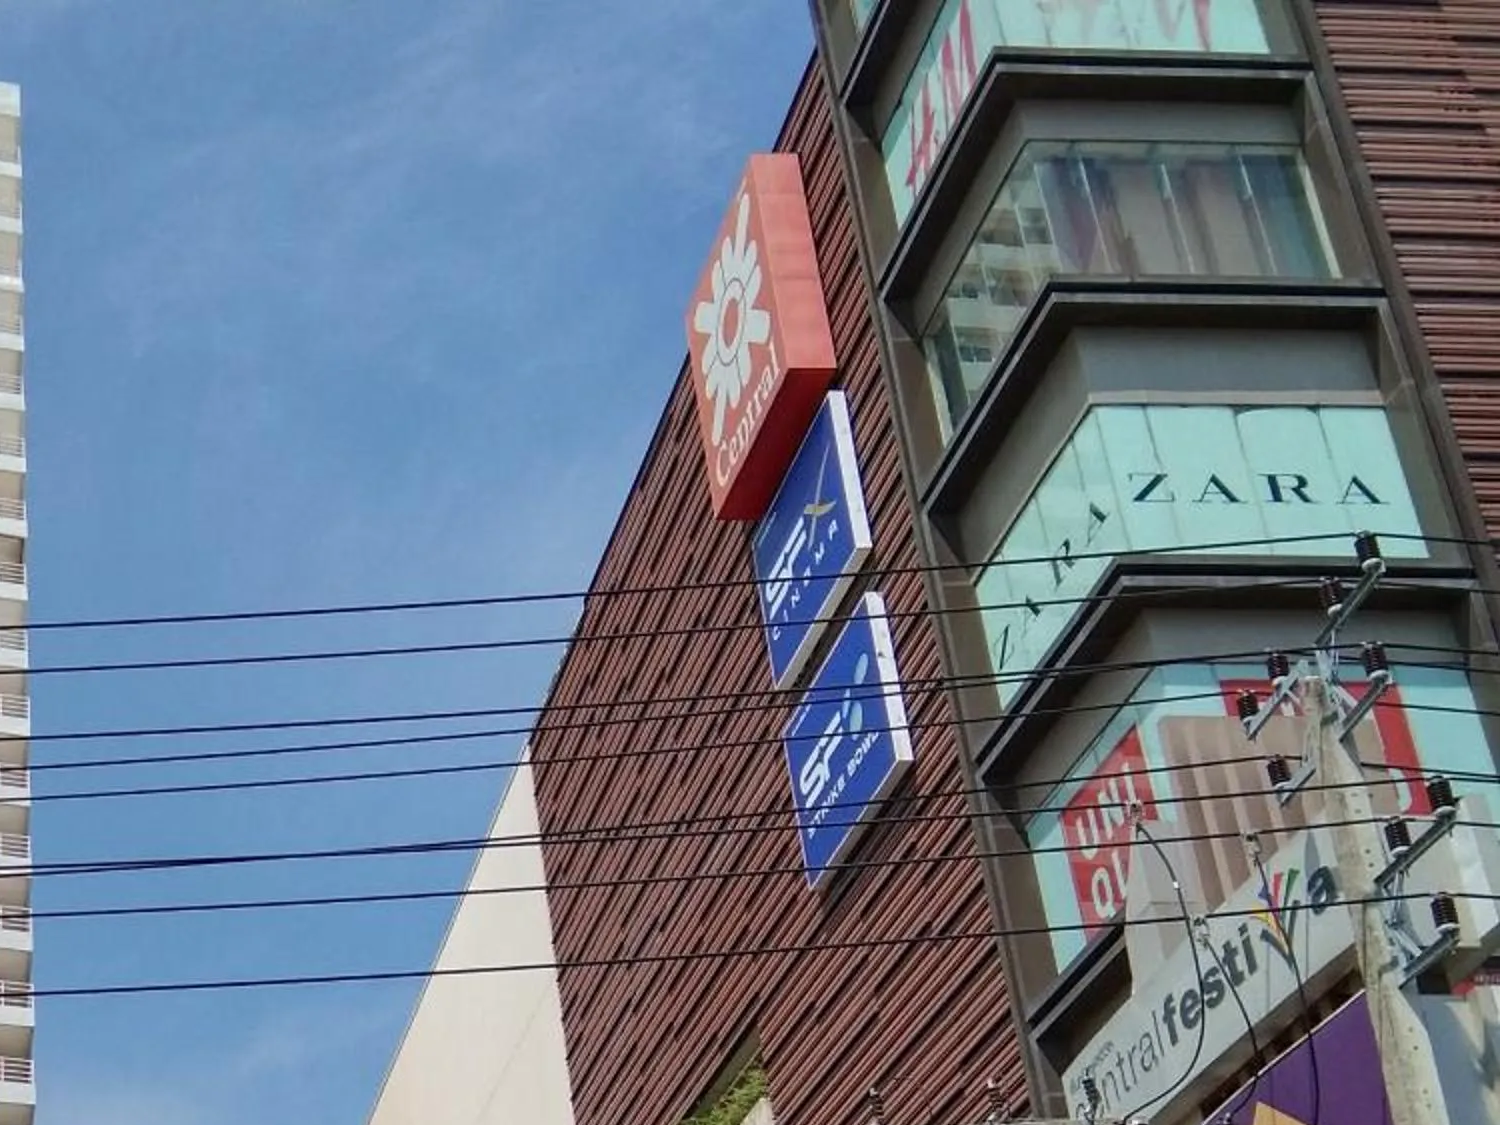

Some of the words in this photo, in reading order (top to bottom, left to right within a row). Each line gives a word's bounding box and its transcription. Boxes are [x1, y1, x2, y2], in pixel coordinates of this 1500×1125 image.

[716, 343, 782, 488] Central
[1128, 473, 1390, 505] ZARA
[994, 502, 1108, 670] ZARA
[847, 731, 879, 777] BOWL
[1076, 760, 1140, 861] UNI
